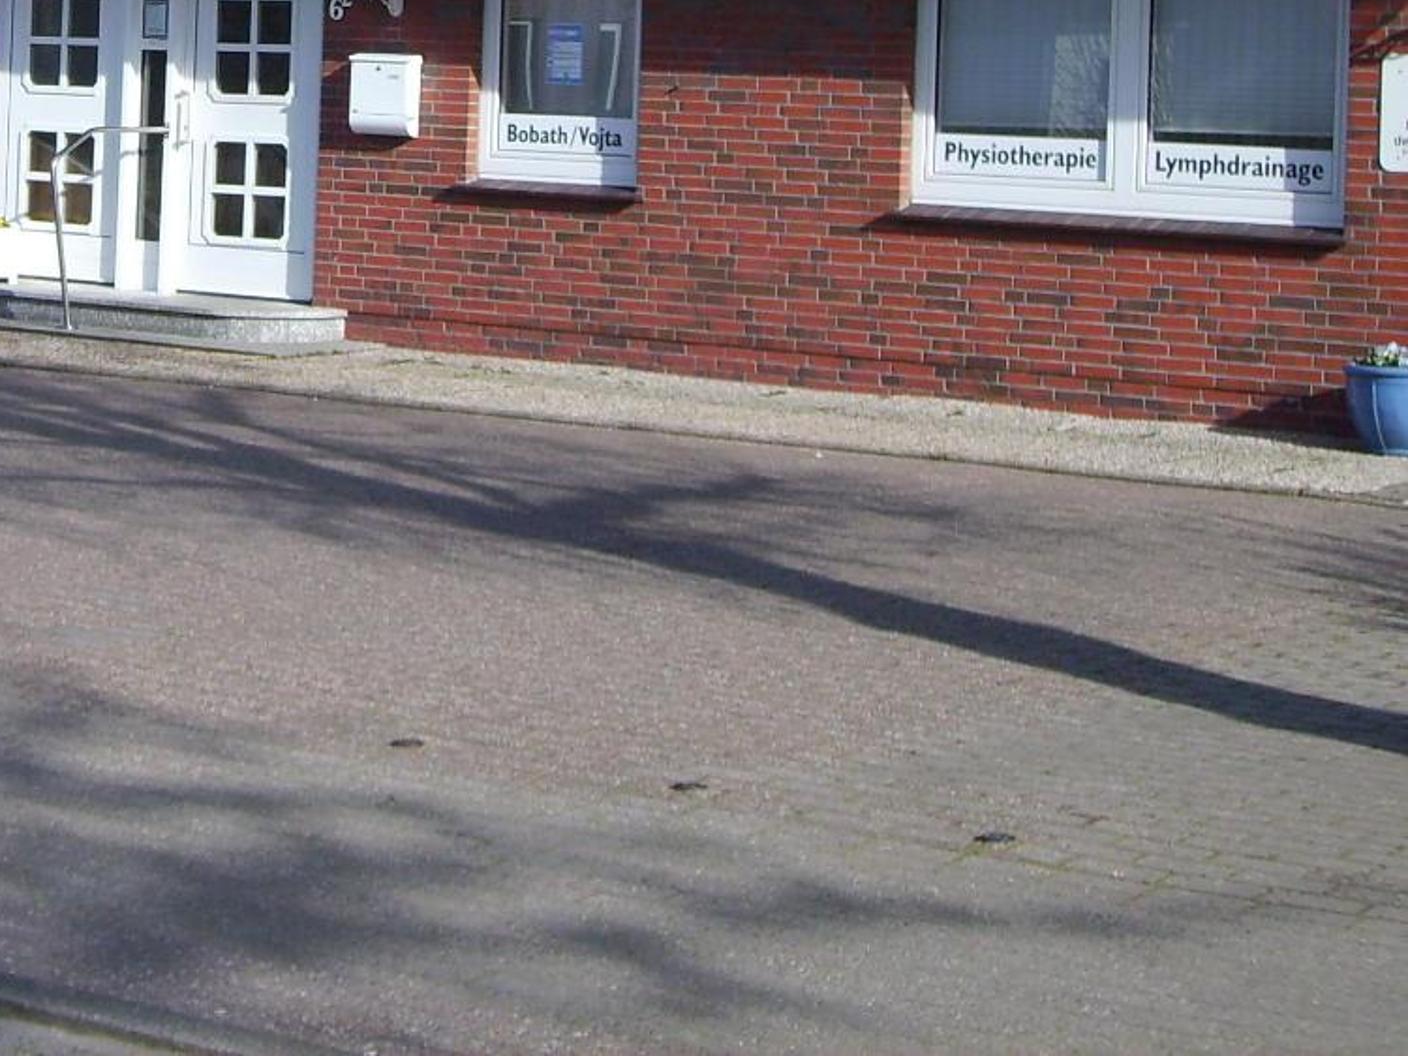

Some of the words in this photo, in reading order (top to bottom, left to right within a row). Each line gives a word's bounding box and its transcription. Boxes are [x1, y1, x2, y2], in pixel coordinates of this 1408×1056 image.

[507, 123, 623, 151] Bobath/Vojta
[944, 141, 1097, 174] Physiotherapie
[1155, 150, 1324, 186] Lymphdrainage
